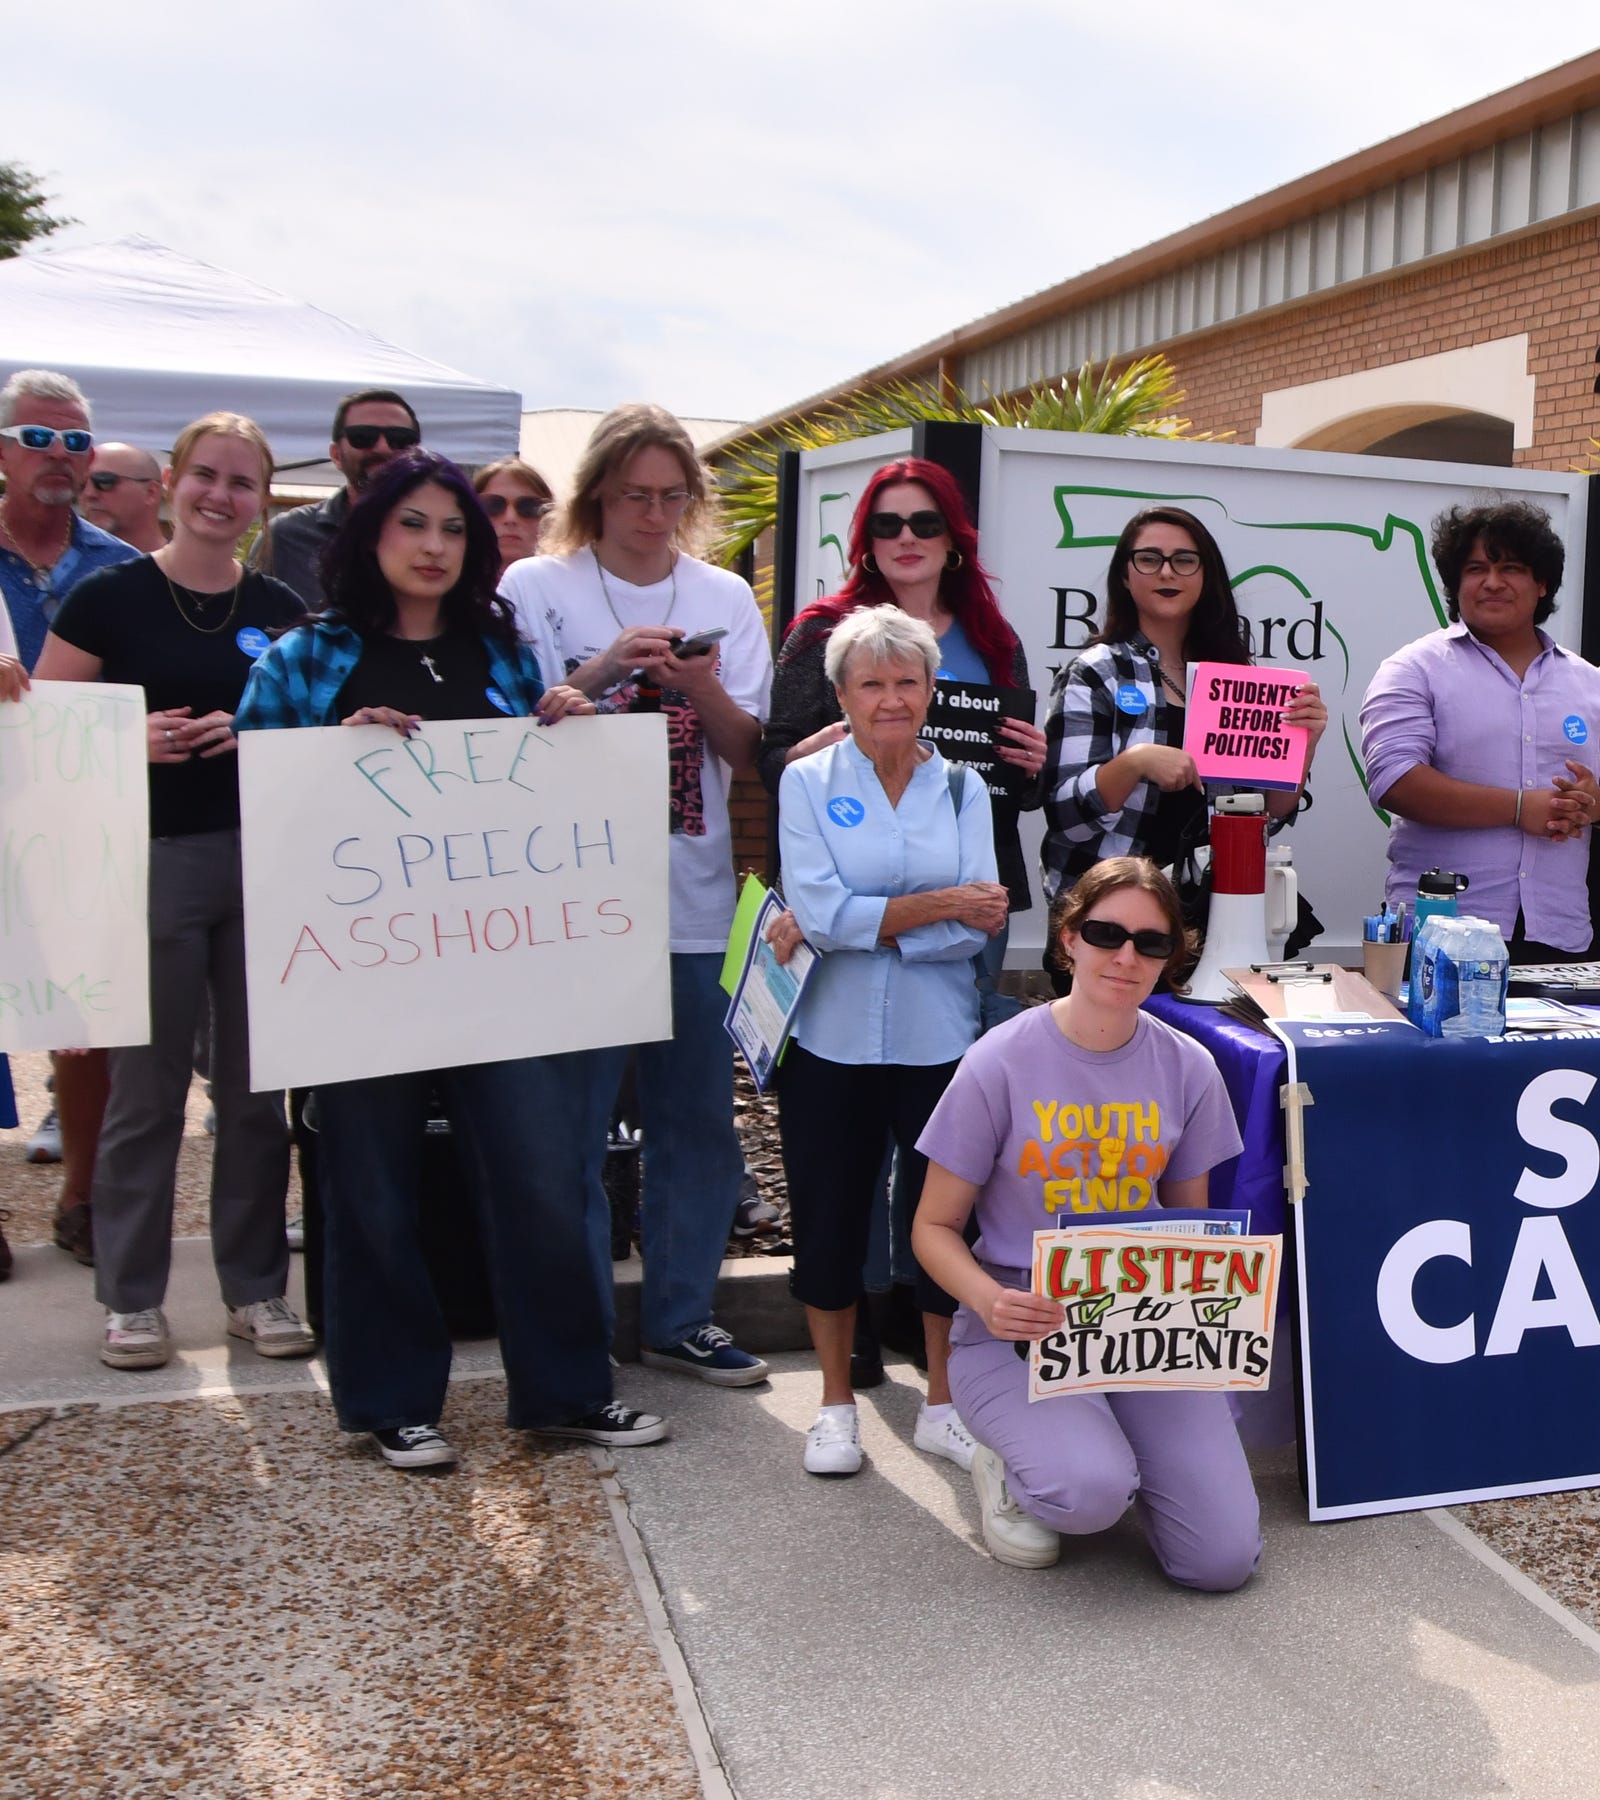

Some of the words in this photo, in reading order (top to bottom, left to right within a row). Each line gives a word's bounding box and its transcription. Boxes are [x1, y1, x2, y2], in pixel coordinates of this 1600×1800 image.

[1046, 586, 1327, 661] Bard
[948, 690, 1000, 712] about
[1209, 678, 1300, 707] STUDENTS
[1219, 706, 1282, 733] BEFORE
[1203, 733, 1290, 760] POLITICS!
[354, 730, 555, 817] FREE
[326, 819, 615, 905] SPEECH
[280, 899, 632, 984] ASSHOLES
[1033, 1100, 1160, 1143] YOUTH
[1044, 1176, 1152, 1214] FUND
[1047, 1245, 1265, 1299] LISTEN
[1110, 1297, 1182, 1321] to
[1039, 1327, 1269, 1381] STUDENTS
